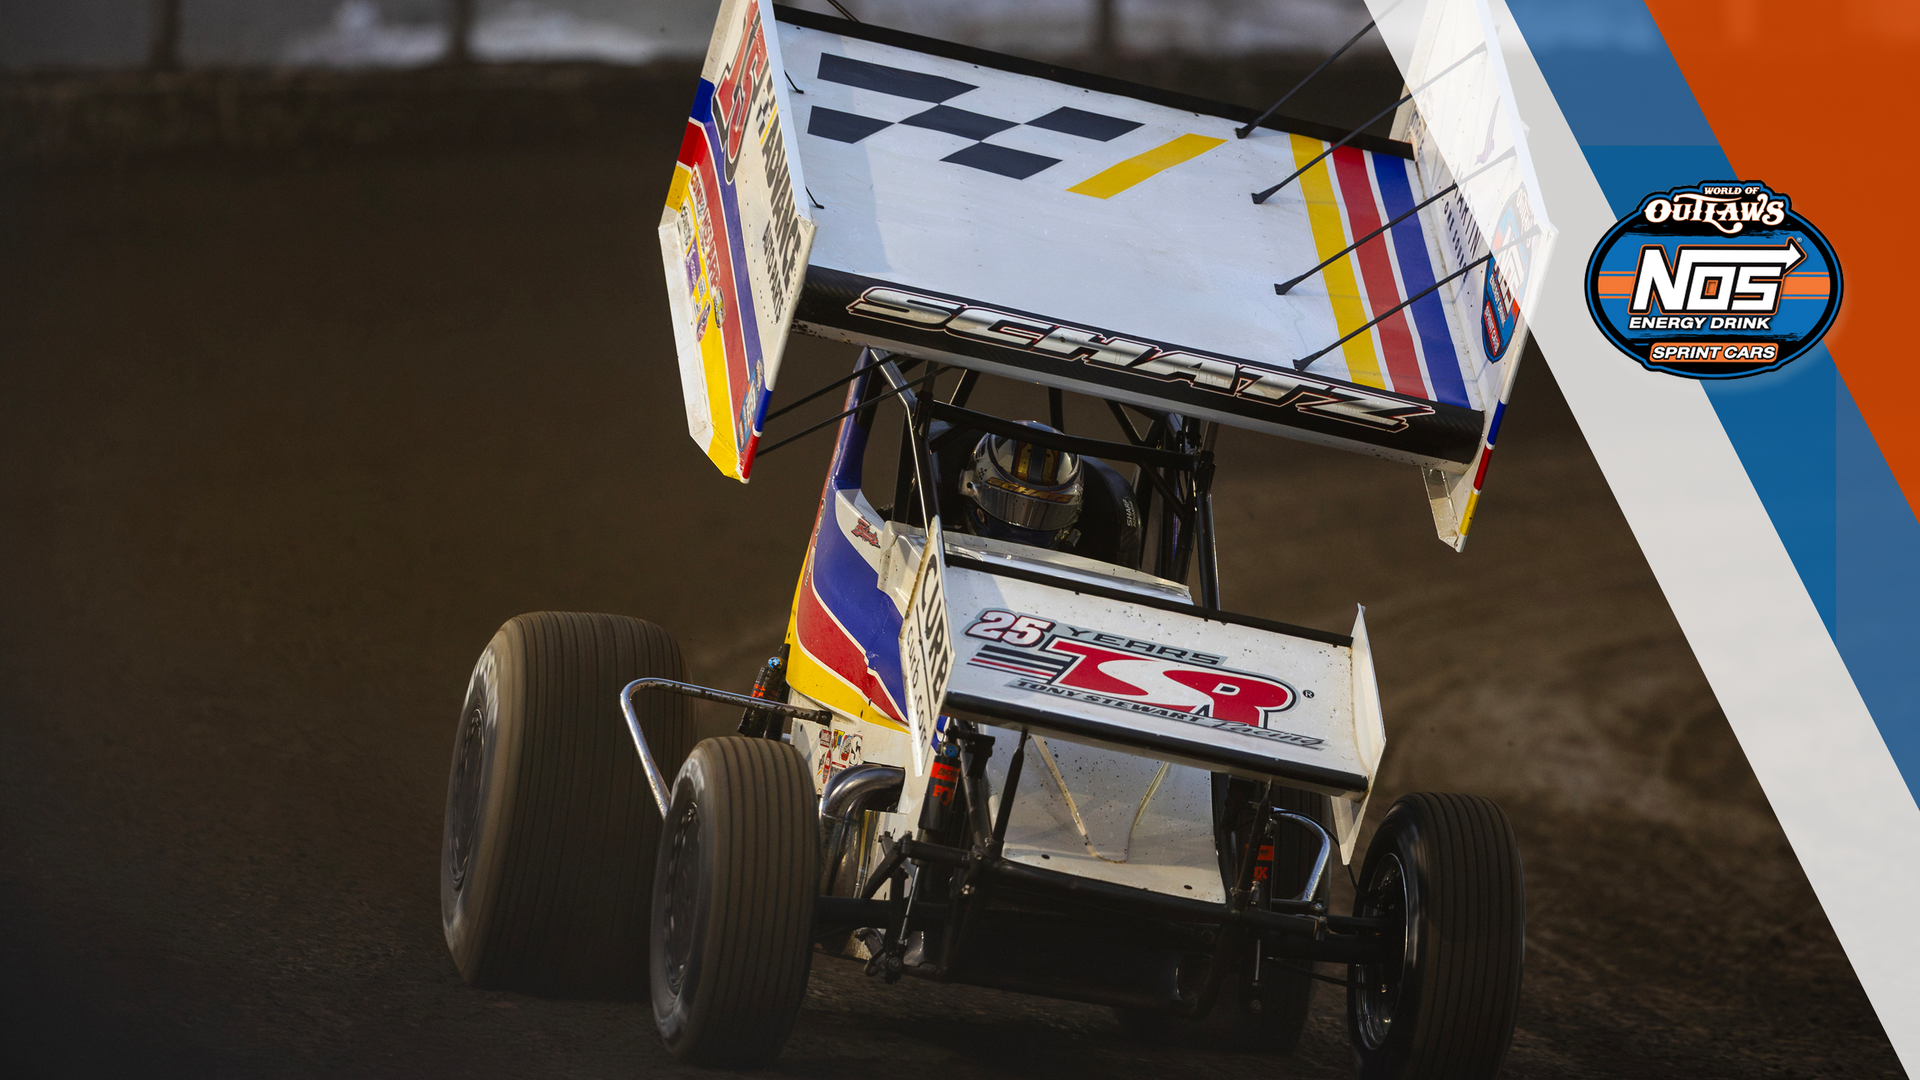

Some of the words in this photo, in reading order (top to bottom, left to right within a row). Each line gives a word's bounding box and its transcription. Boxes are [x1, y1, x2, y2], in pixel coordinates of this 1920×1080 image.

[762, 113, 801, 293] ADVANCE
[846, 285, 1436, 432] SCHATZ
[921, 554, 949, 705] CURB
[963, 609, 1055, 648] 25
[1064, 626, 1221, 666] YEARS
[1015, 678, 1080, 700] TONY
[1081, 692, 1203, 723] STEWART
